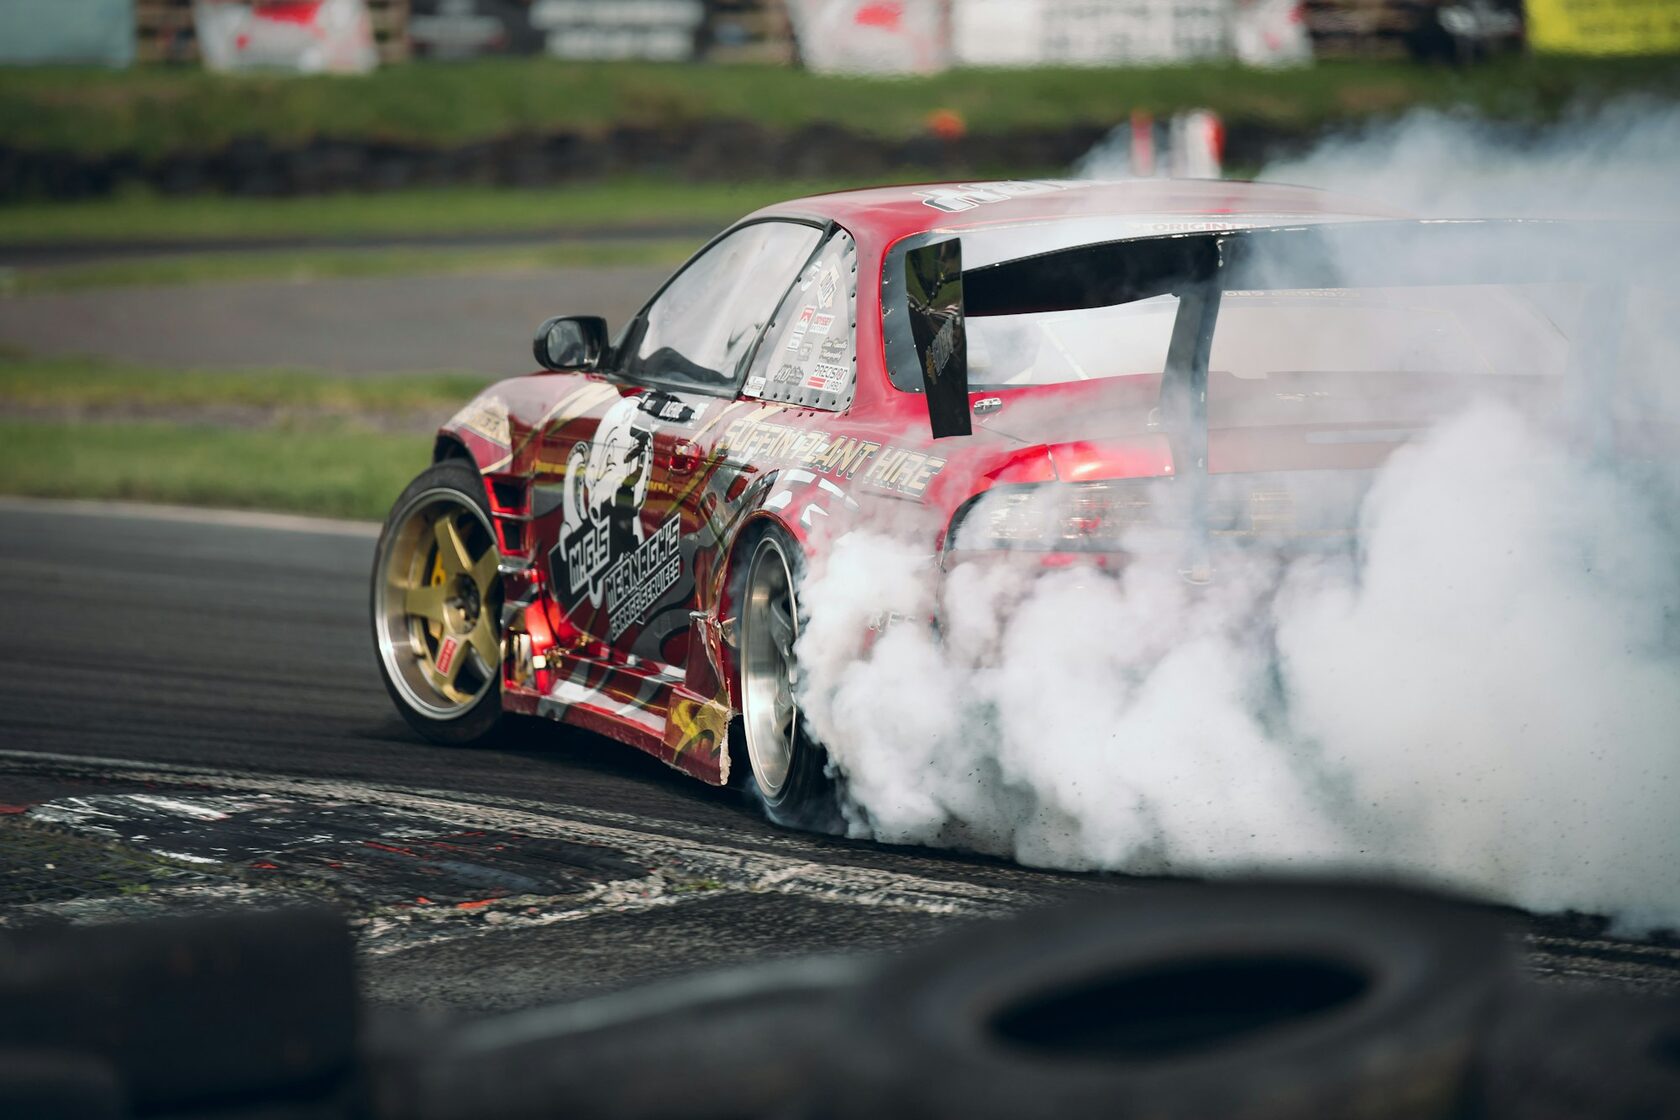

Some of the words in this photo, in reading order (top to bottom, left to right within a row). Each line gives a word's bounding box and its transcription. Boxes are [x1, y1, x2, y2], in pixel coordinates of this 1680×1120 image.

[1151, 222, 1228, 232] ORIGIN
[789, 431, 881, 478] PLANT
[863, 447, 947, 497] HIRE
